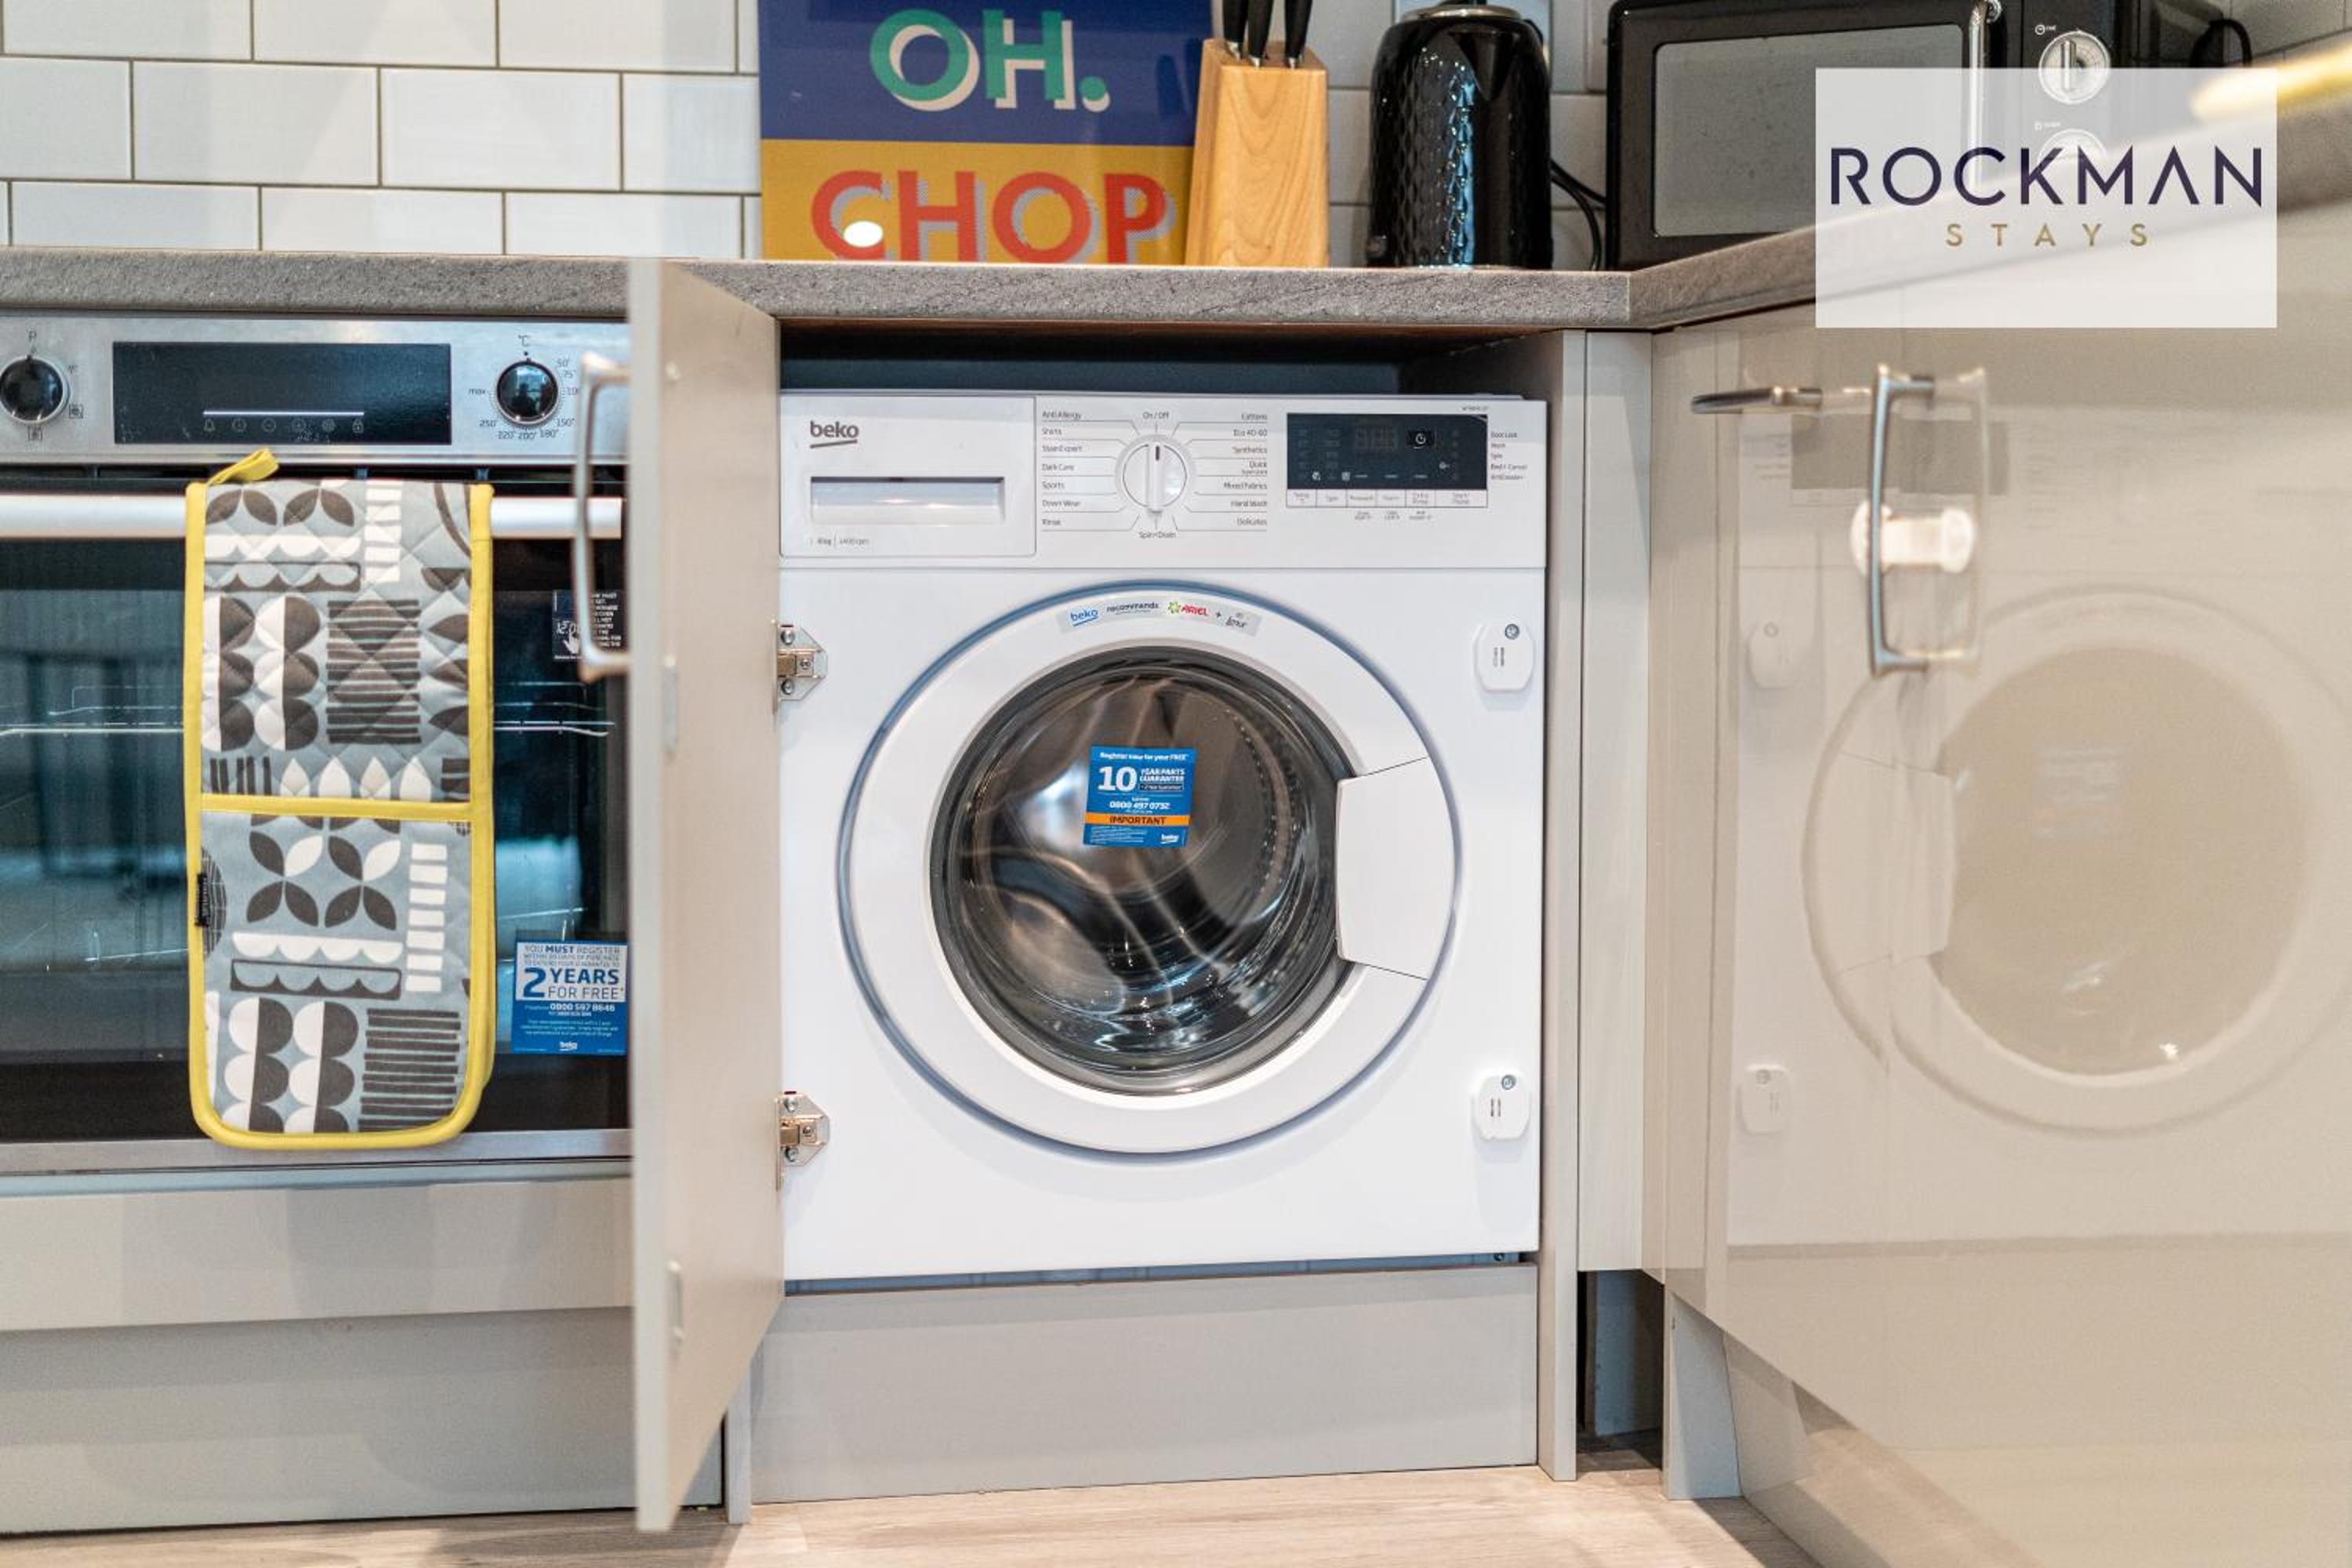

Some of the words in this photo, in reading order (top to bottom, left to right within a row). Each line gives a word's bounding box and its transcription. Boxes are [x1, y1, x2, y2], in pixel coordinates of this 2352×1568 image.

[869, 9, 1111, 112] OH.
[810, 169, 1176, 264] CHOP
[810, 421, 859, 438] beko
[1070, 608, 1098, 621] beko
[1098, 766, 1138, 791] 10
[1109, 816, 1167, 825] IMPORTANT
[546, 946, 574, 954] MUST
[523, 967, 546, 998] 2
[550, 967, 619, 985] YEARS
[548, 986, 577, 999] FOR
